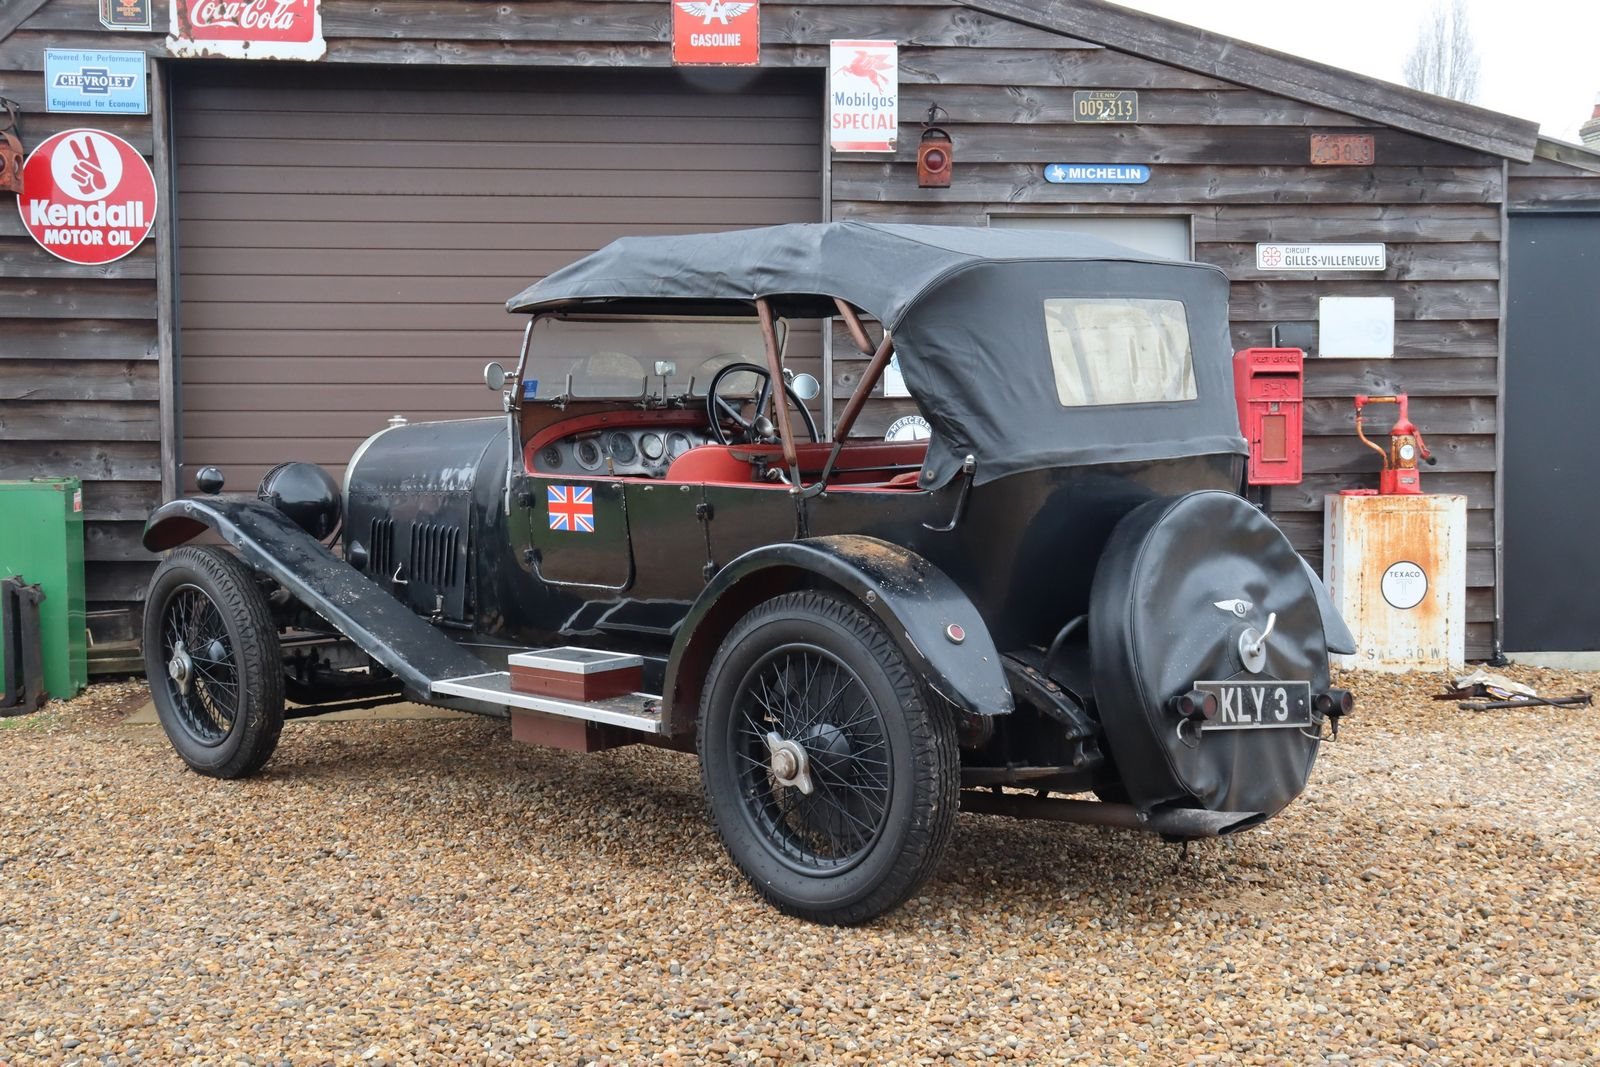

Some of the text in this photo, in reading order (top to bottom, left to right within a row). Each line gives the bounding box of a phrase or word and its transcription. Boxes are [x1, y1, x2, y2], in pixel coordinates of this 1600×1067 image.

[190, 0, 295, 30] Coca-Cola
[690, 33, 741, 47] GASOLINE
[47, 52, 142, 64] Powered for Performance
[60, 73, 131, 88] CHEVROLET
[52, 98, 141, 110] Engineered for Economy
[832, 113, 897, 130] SPECIAL
[1068, 167, 1141, 180] MICHELIN
[43, 229, 135, 246] MOTOR OIL
[1389, 570, 1421, 578] TEXACO
[1220, 687, 1289, 723] KLY 3
